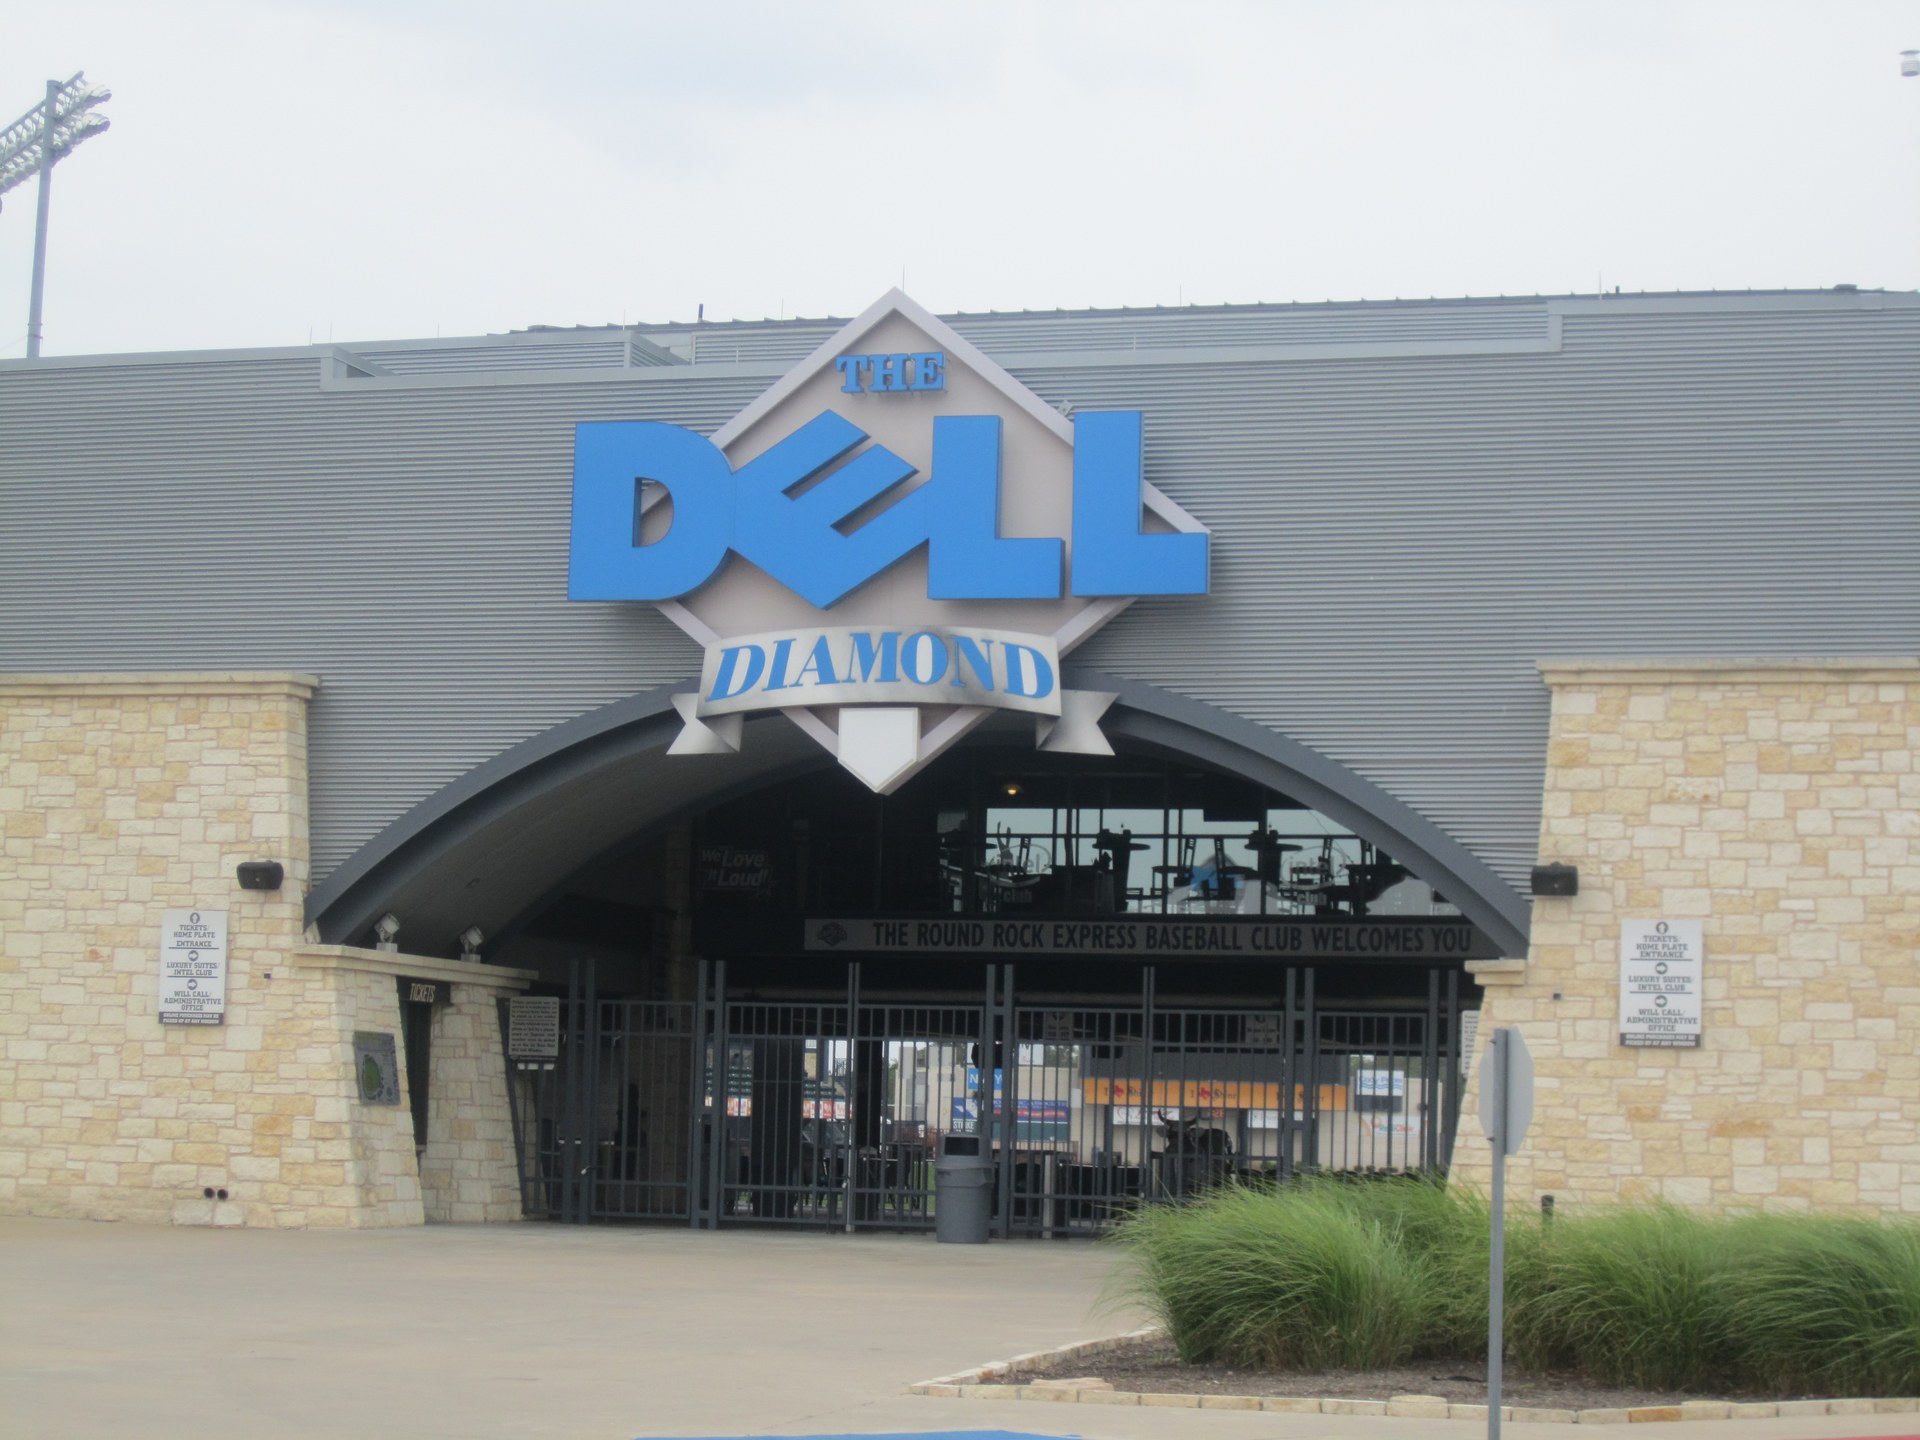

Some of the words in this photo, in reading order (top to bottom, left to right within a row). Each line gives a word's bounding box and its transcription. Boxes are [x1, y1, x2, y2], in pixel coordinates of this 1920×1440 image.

[836, 351, 945, 393] THE
[566, 408, 1212, 610] DELL
[705, 630, 1056, 702] DIAMOND
[873, 922, 908, 946] THE
[917, 922, 984, 947] ROUND
[993, 923, 1044, 948] ROCK
[1053, 924, 1136, 949] EXPRESS
[1147, 925, 1242, 950] BASEBALL
[1251, 926, 1302, 951] CLUB
[1312, 927, 1424, 952] WELCOMES
[1431, 928, 1472, 952] YOU
[1661, 943, 1688, 951] PLATE
[410, 983, 435, 1002] TICKETS
[1648, 1024, 1676, 1032] OFFICE
